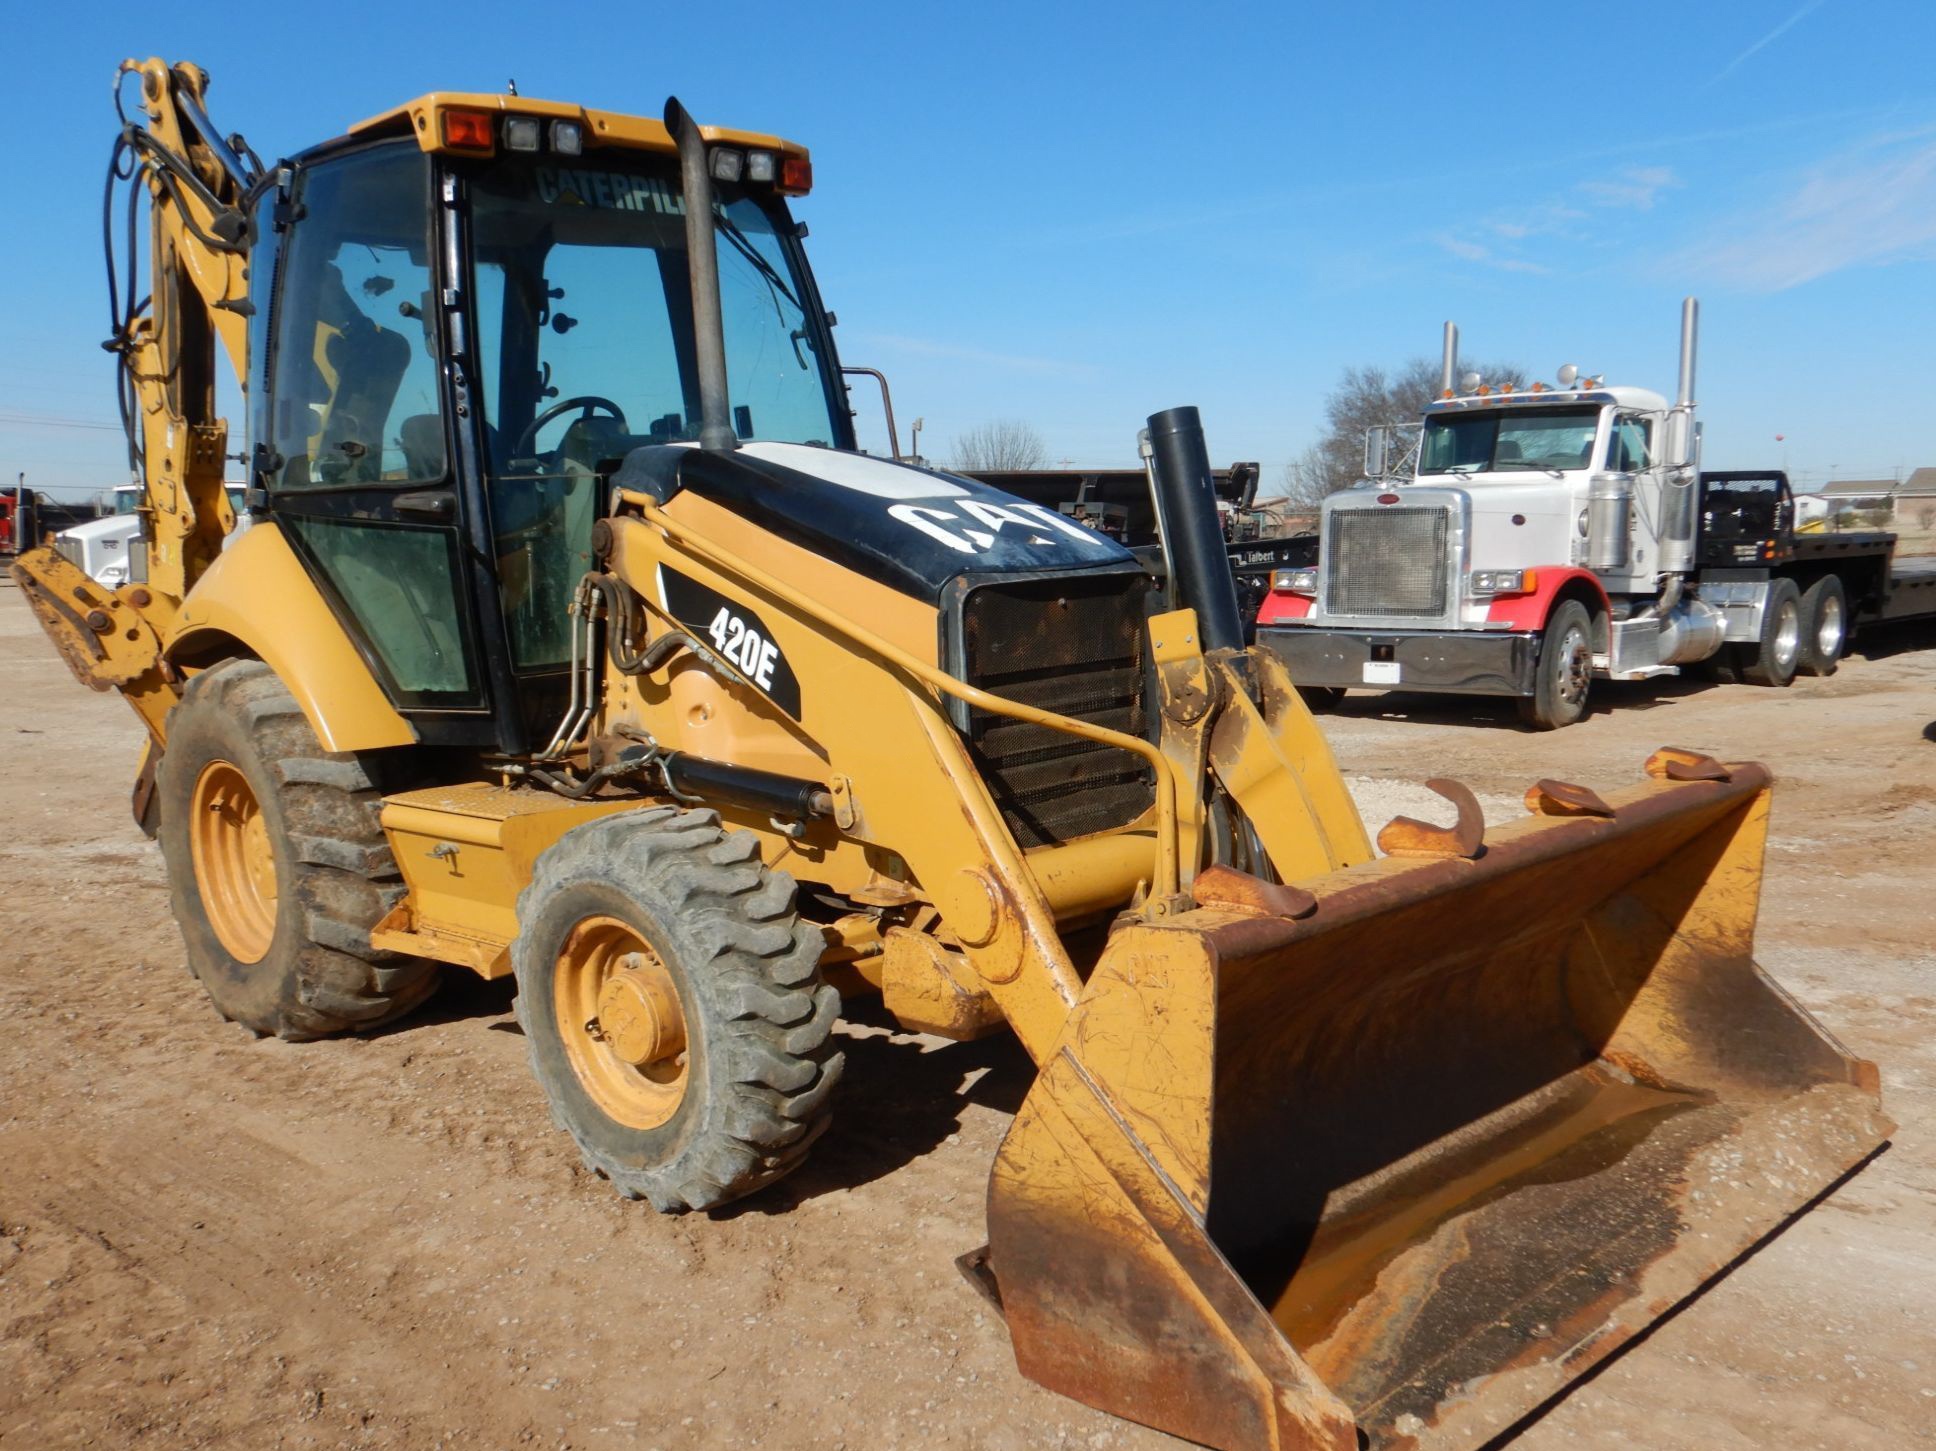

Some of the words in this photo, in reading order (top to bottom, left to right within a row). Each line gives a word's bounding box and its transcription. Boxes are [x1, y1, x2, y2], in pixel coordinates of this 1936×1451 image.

[887, 499, 1102, 554] CAT
[1246, 550, 1275, 563] Talbert
[709, 606, 778, 692] 420E
